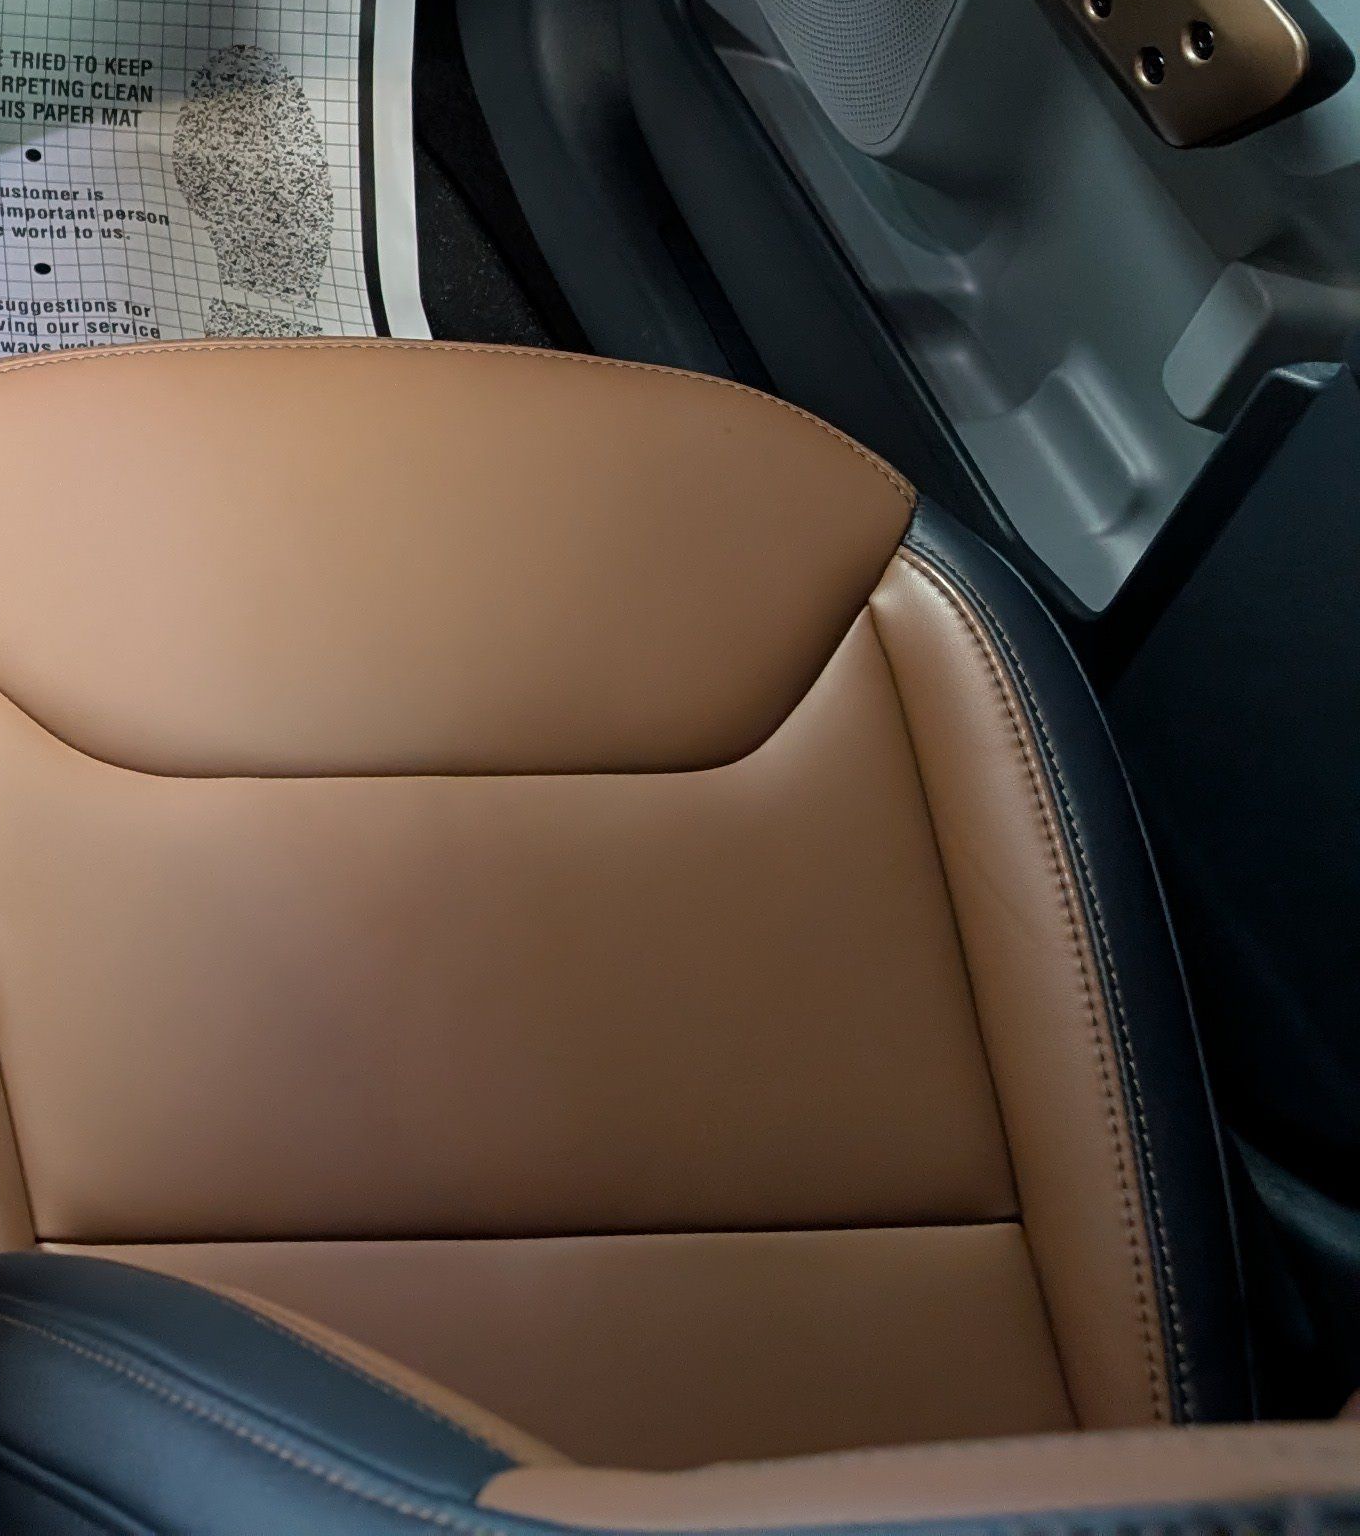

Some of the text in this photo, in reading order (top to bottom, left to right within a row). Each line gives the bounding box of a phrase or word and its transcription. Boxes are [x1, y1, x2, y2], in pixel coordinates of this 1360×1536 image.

[9, 50, 66, 72] TRIED
[72, 55, 98, 74] TO
[104, 57, 153, 77] KEEP
[90, 82, 153, 103] CLEAN
[33, 102, 94, 125] PAPER
[101, 107, 142, 128] MAT
[87, 188, 104, 202] is
[0, 203, 97, 221] important
[103, 208, 170, 226] person
[11, 225, 67, 240] world
[74, 226, 93, 239] to
[101, 227, 131, 240] us.
[124, 300, 151, 318] for
[46, 321, 79, 334] our
[86, 320, 161, 339] service
